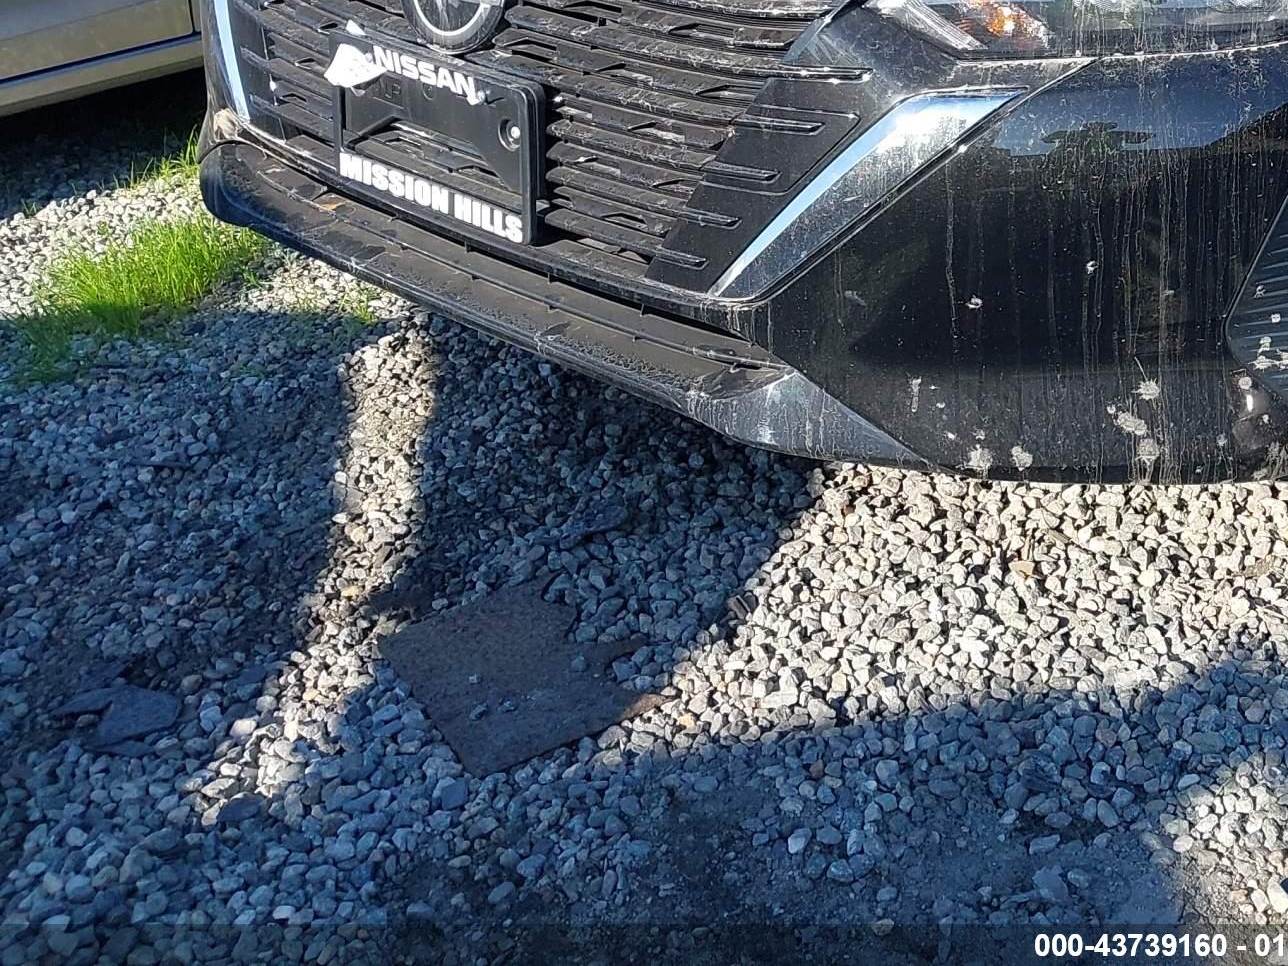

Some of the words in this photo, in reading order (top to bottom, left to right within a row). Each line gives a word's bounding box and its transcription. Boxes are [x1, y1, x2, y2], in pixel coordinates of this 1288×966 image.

[372, 45, 478, 105] NISSAN
[339, 152, 449, 215] MISSION
[453, 192, 524, 244] HILLS
